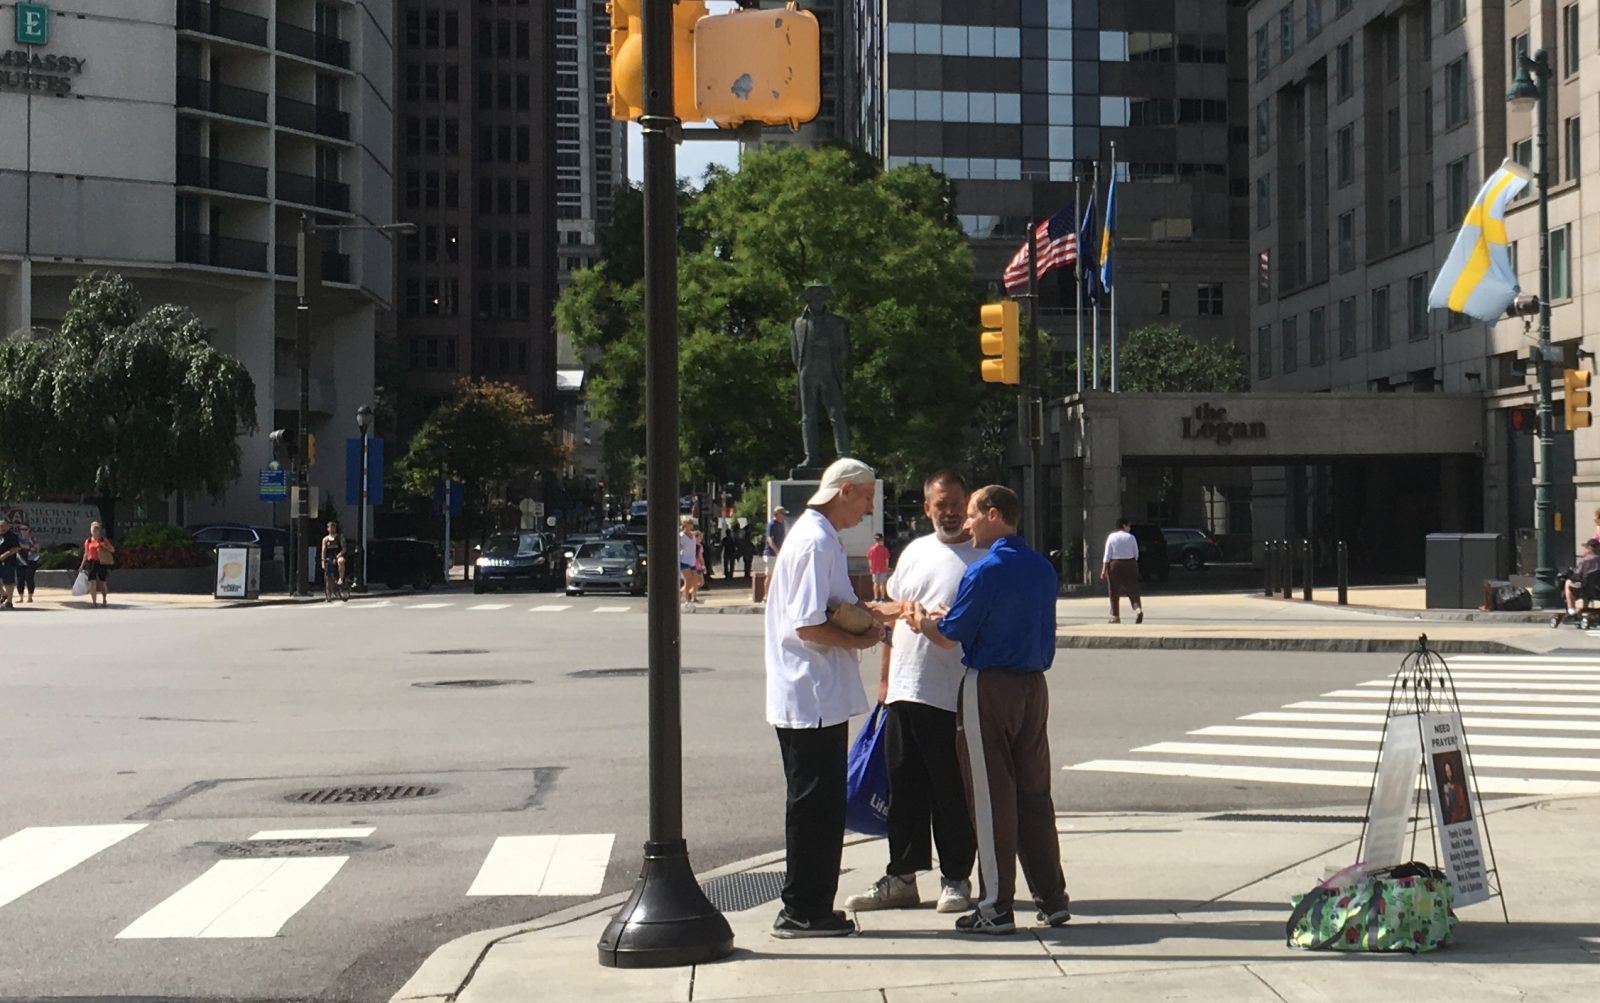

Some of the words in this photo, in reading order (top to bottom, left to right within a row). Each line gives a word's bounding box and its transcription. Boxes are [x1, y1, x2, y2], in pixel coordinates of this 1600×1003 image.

[25, 11, 41, 35] E
[1195, 402, 1227, 420] the
[1181, 417, 1266, 446] Logan
[1434, 723, 1450, 733] NEED
[1432, 736, 1458, 747] PRAYER?
